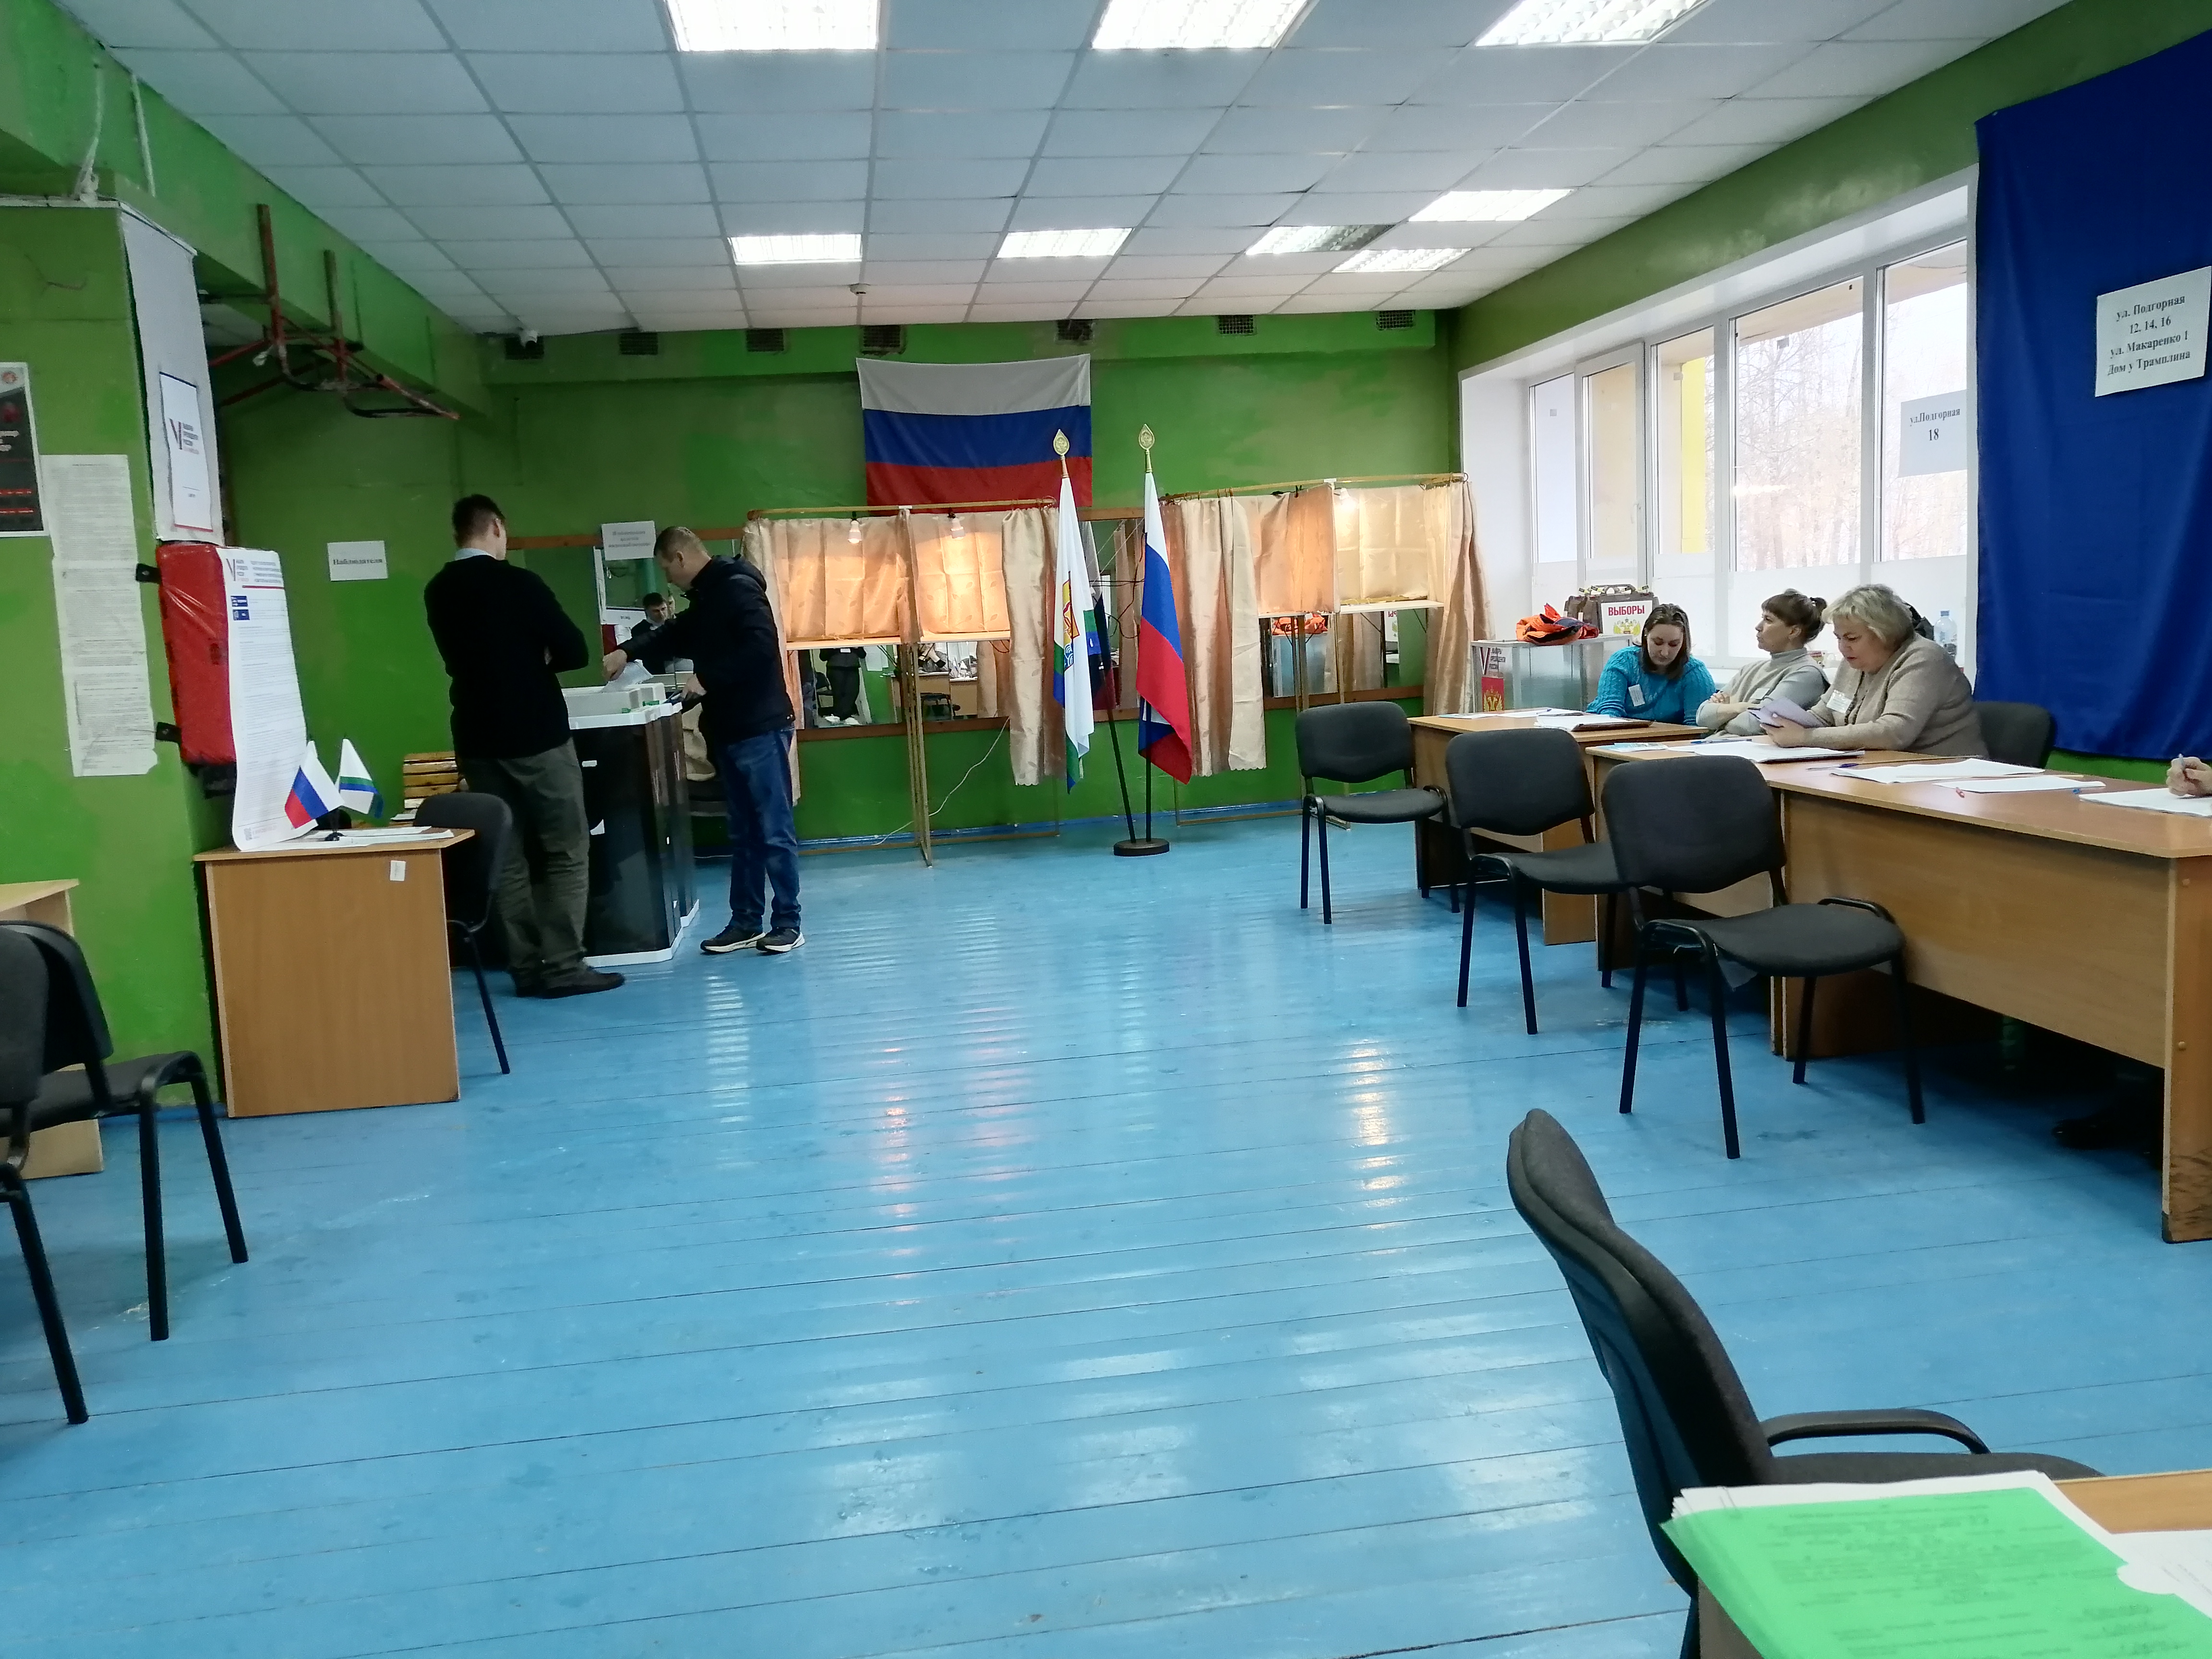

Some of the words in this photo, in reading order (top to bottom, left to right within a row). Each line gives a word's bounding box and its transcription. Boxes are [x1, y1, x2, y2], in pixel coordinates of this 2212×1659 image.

[2116, 309, 2130, 322] ул.
[2134, 296, 2185, 315] Подгорная
[2161, 316, 2171, 327] 16
[2110, 347, 2124, 359] ул.
[2127, 335, 2181, 353] Макаренко
[2185, 330, 2188, 341] 1
[2108, 364, 2126, 376] Дом
[2128, 363, 2133, 373] у
[2136, 351, 2190, 370] Трамплина
[1910, 409, 1960, 426] ул.Подгорная
[1929, 428, 1939, 441] 18
[1608, 605, 1645, 616] ВЫБОРЫ
